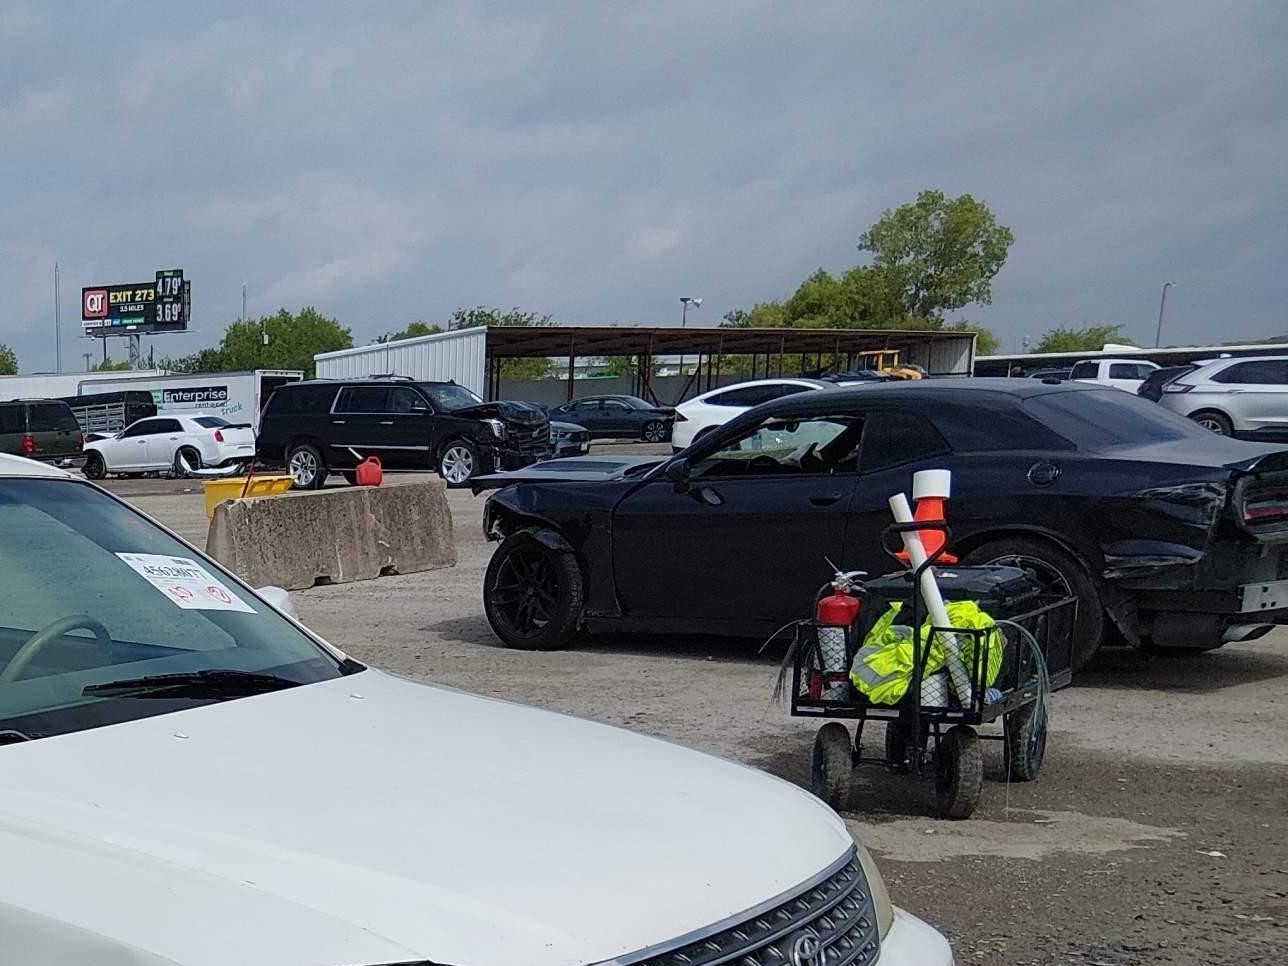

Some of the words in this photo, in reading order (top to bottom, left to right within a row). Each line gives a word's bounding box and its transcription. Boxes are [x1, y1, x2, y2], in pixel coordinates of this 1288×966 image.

[110, 291, 132, 303] EXIT
[135, 289, 155, 301] 273
[87, 294, 104, 313] QT
[164, 388, 227, 402] Enterprise
[221, 402, 243, 416] truck
[143, 565, 206, 579] 45628077
